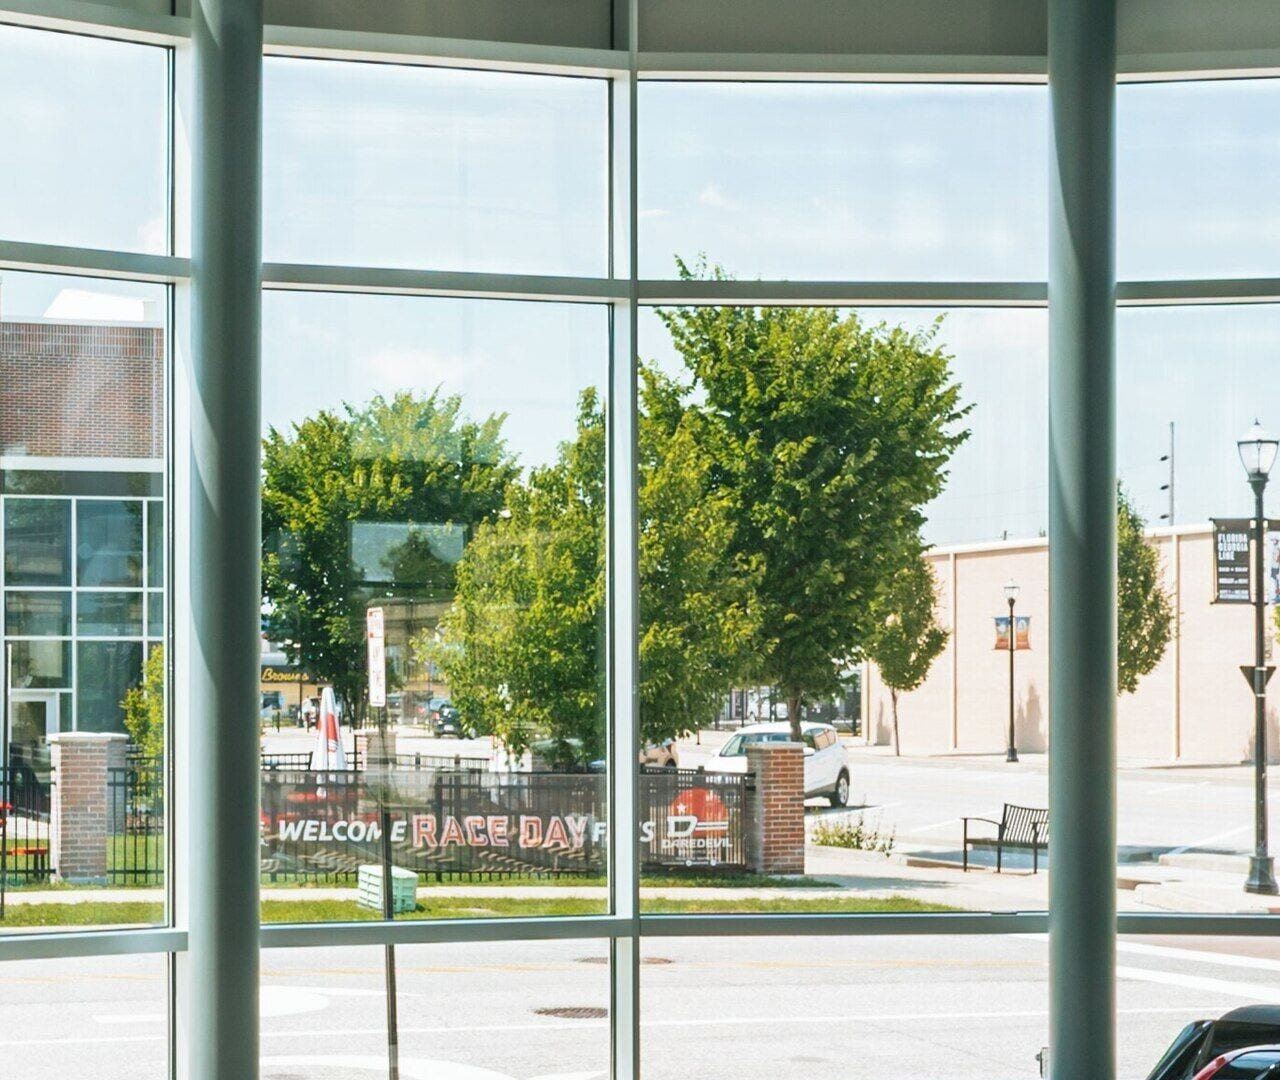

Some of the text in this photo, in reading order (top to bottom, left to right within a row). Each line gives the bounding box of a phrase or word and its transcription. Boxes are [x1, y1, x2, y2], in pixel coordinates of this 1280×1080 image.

[1217, 533, 1248, 543] FLORIDA
[1217, 543, 1249, 552] GEORGIA
[279, 820, 408, 842] WELCOME
[412, 814, 509, 847] RACE
[519, 815, 588, 848] DAY
[593, 821, 657, 843] FS
[660, 838, 734, 849] DAREDEVIL
